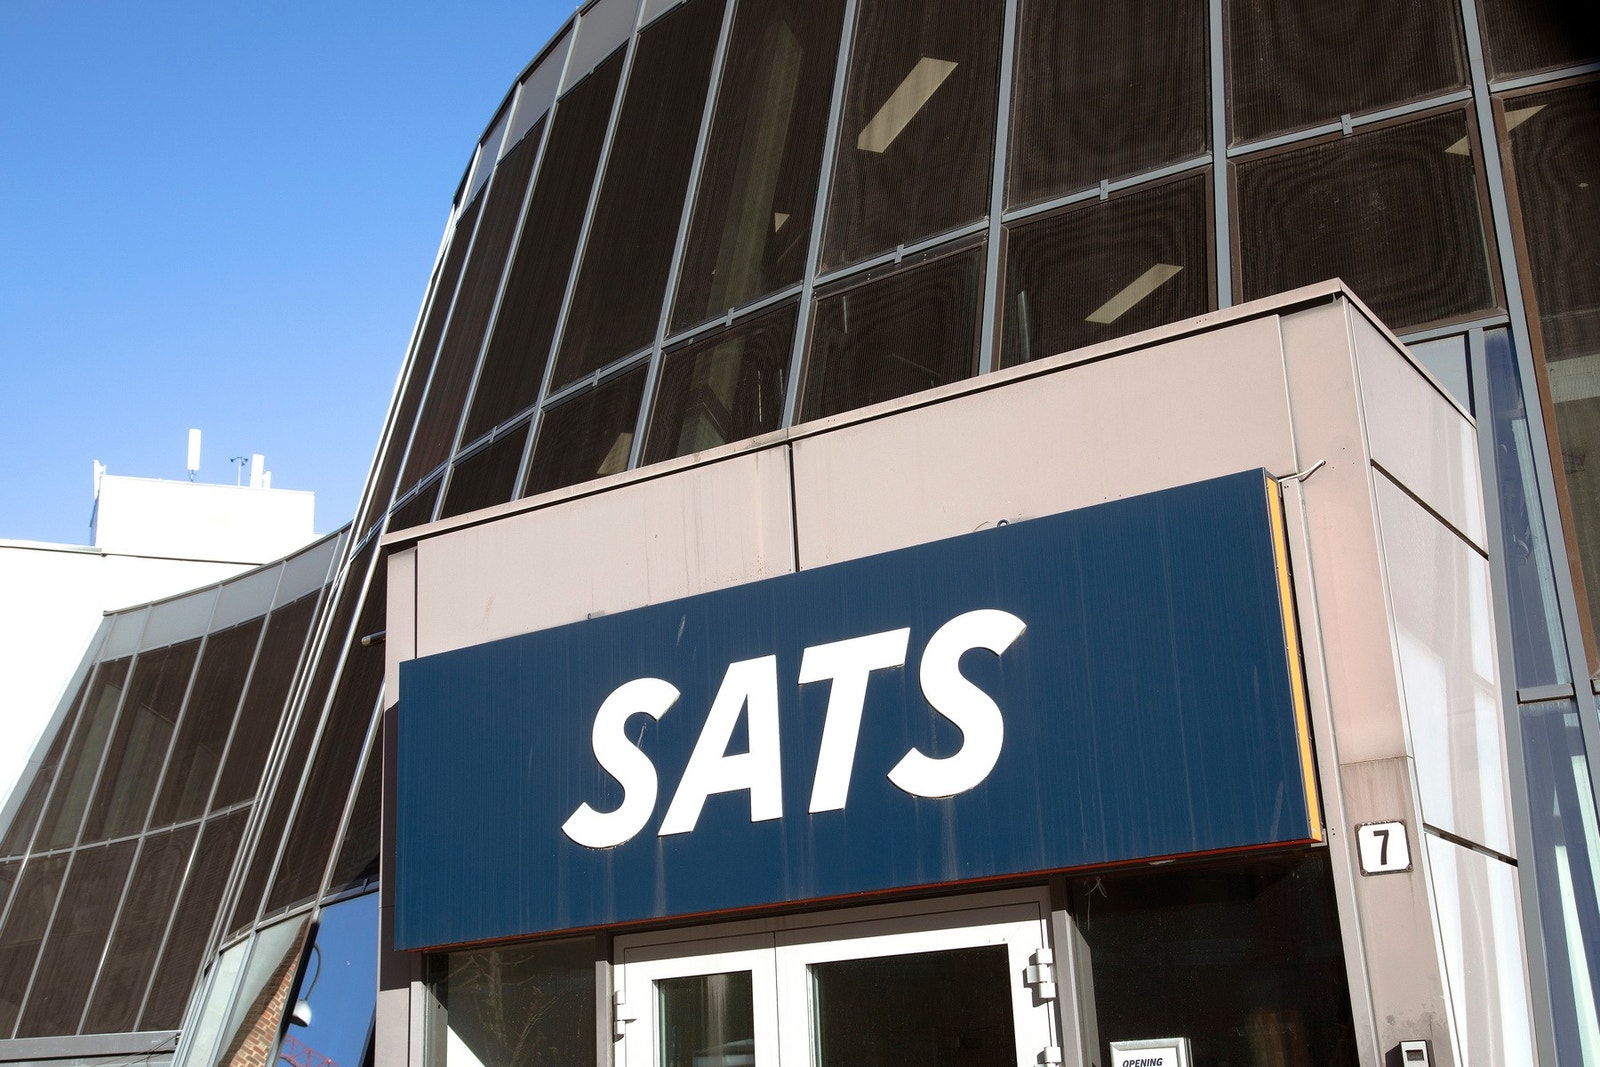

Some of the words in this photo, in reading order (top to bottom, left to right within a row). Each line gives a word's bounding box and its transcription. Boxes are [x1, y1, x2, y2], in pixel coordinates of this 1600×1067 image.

[562, 609, 1027, 849] SATS
[1373, 829, 1389, 865] 7
[1122, 1058, 1163, 1067] OPENING
